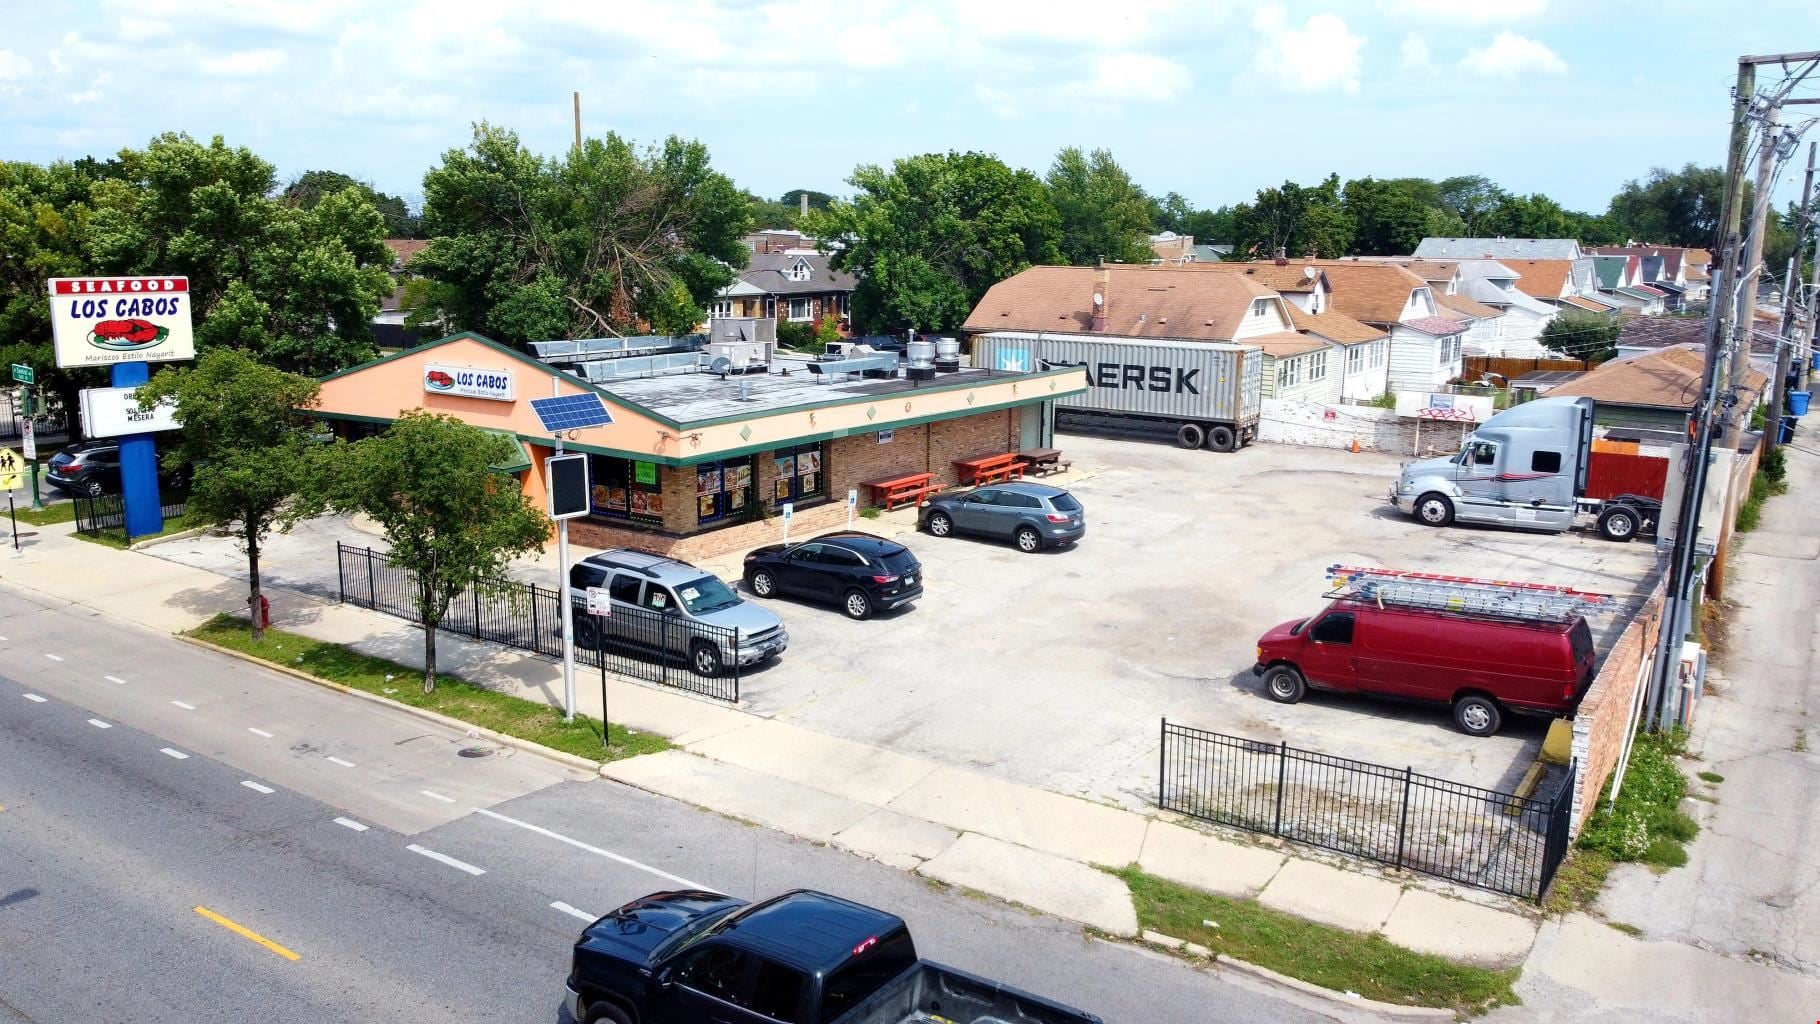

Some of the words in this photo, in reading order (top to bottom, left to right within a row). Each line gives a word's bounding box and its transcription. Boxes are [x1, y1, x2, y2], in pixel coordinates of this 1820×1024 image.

[71, 280, 174, 292] SEAFOOD
[71, 299, 108, 318] LOS
[115, 297, 179, 317] CABOS
[122, 352, 143, 360] Estilo
[457, 371, 473, 386] LOS
[476, 374, 507, 390] CABOS
[127, 413, 154, 422] MESERA
